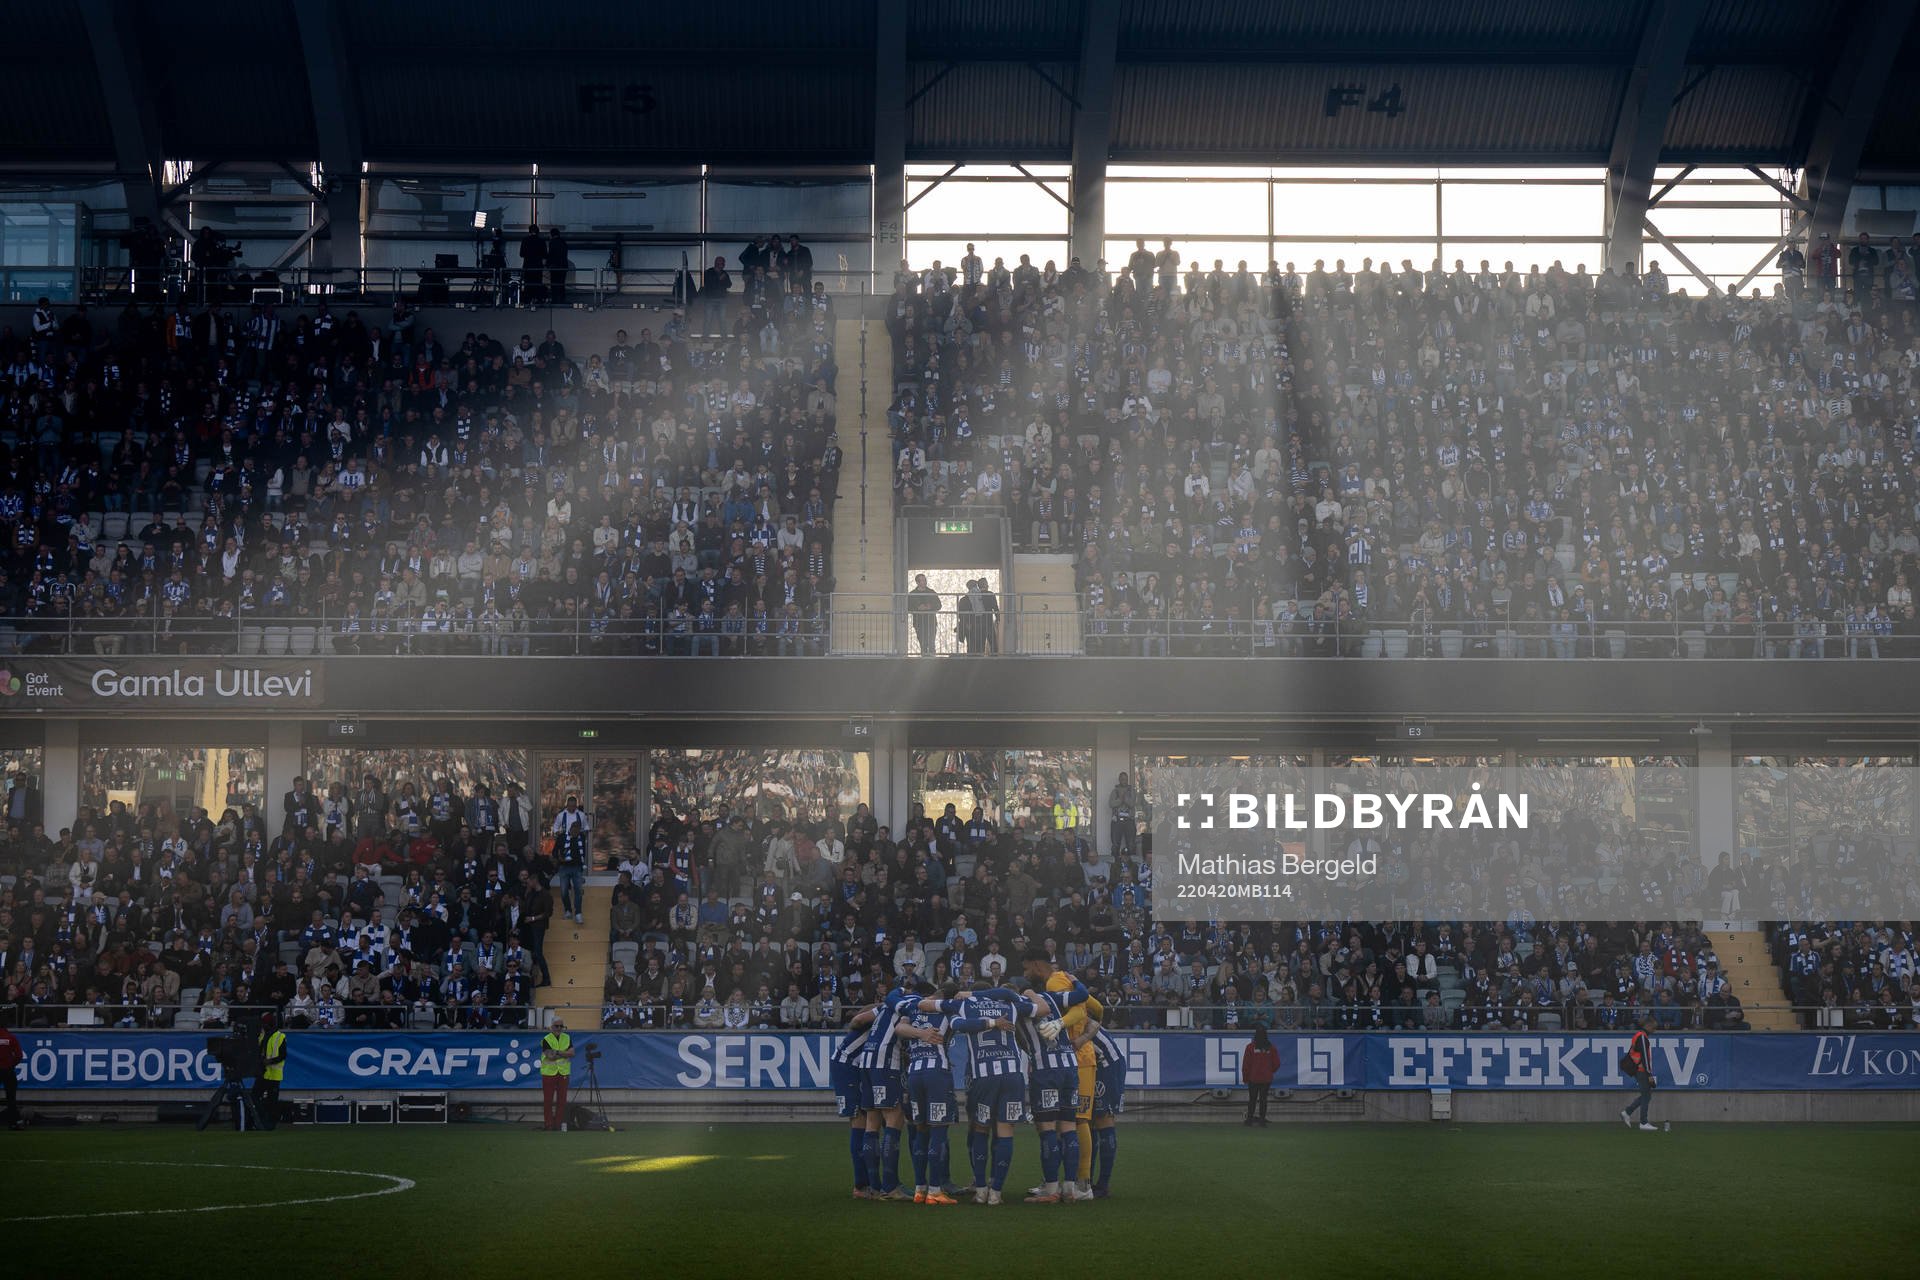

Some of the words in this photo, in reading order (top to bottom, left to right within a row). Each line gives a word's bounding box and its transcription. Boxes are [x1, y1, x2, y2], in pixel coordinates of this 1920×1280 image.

[579, 85, 656, 114] F5
[1327, 83, 1405, 117] F4
[25, 672, 49, 684] Got
[26, 684, 64, 696] Event
[91, 669, 204, 697] Gamla
[215, 669, 312, 697] Ullevi
[341, 725, 354, 734] E5
[854, 726, 867, 735] E4
[1408, 727, 1421, 736] E3
[979, 1009, 1002, 1017] THERN
[348, 1046, 500, 1077] CRAFT
[676, 1035, 846, 1068] SERN
[1388, 1037, 1705, 1086] EFFEKTV
[1807, 1034, 1857, 1075] El
